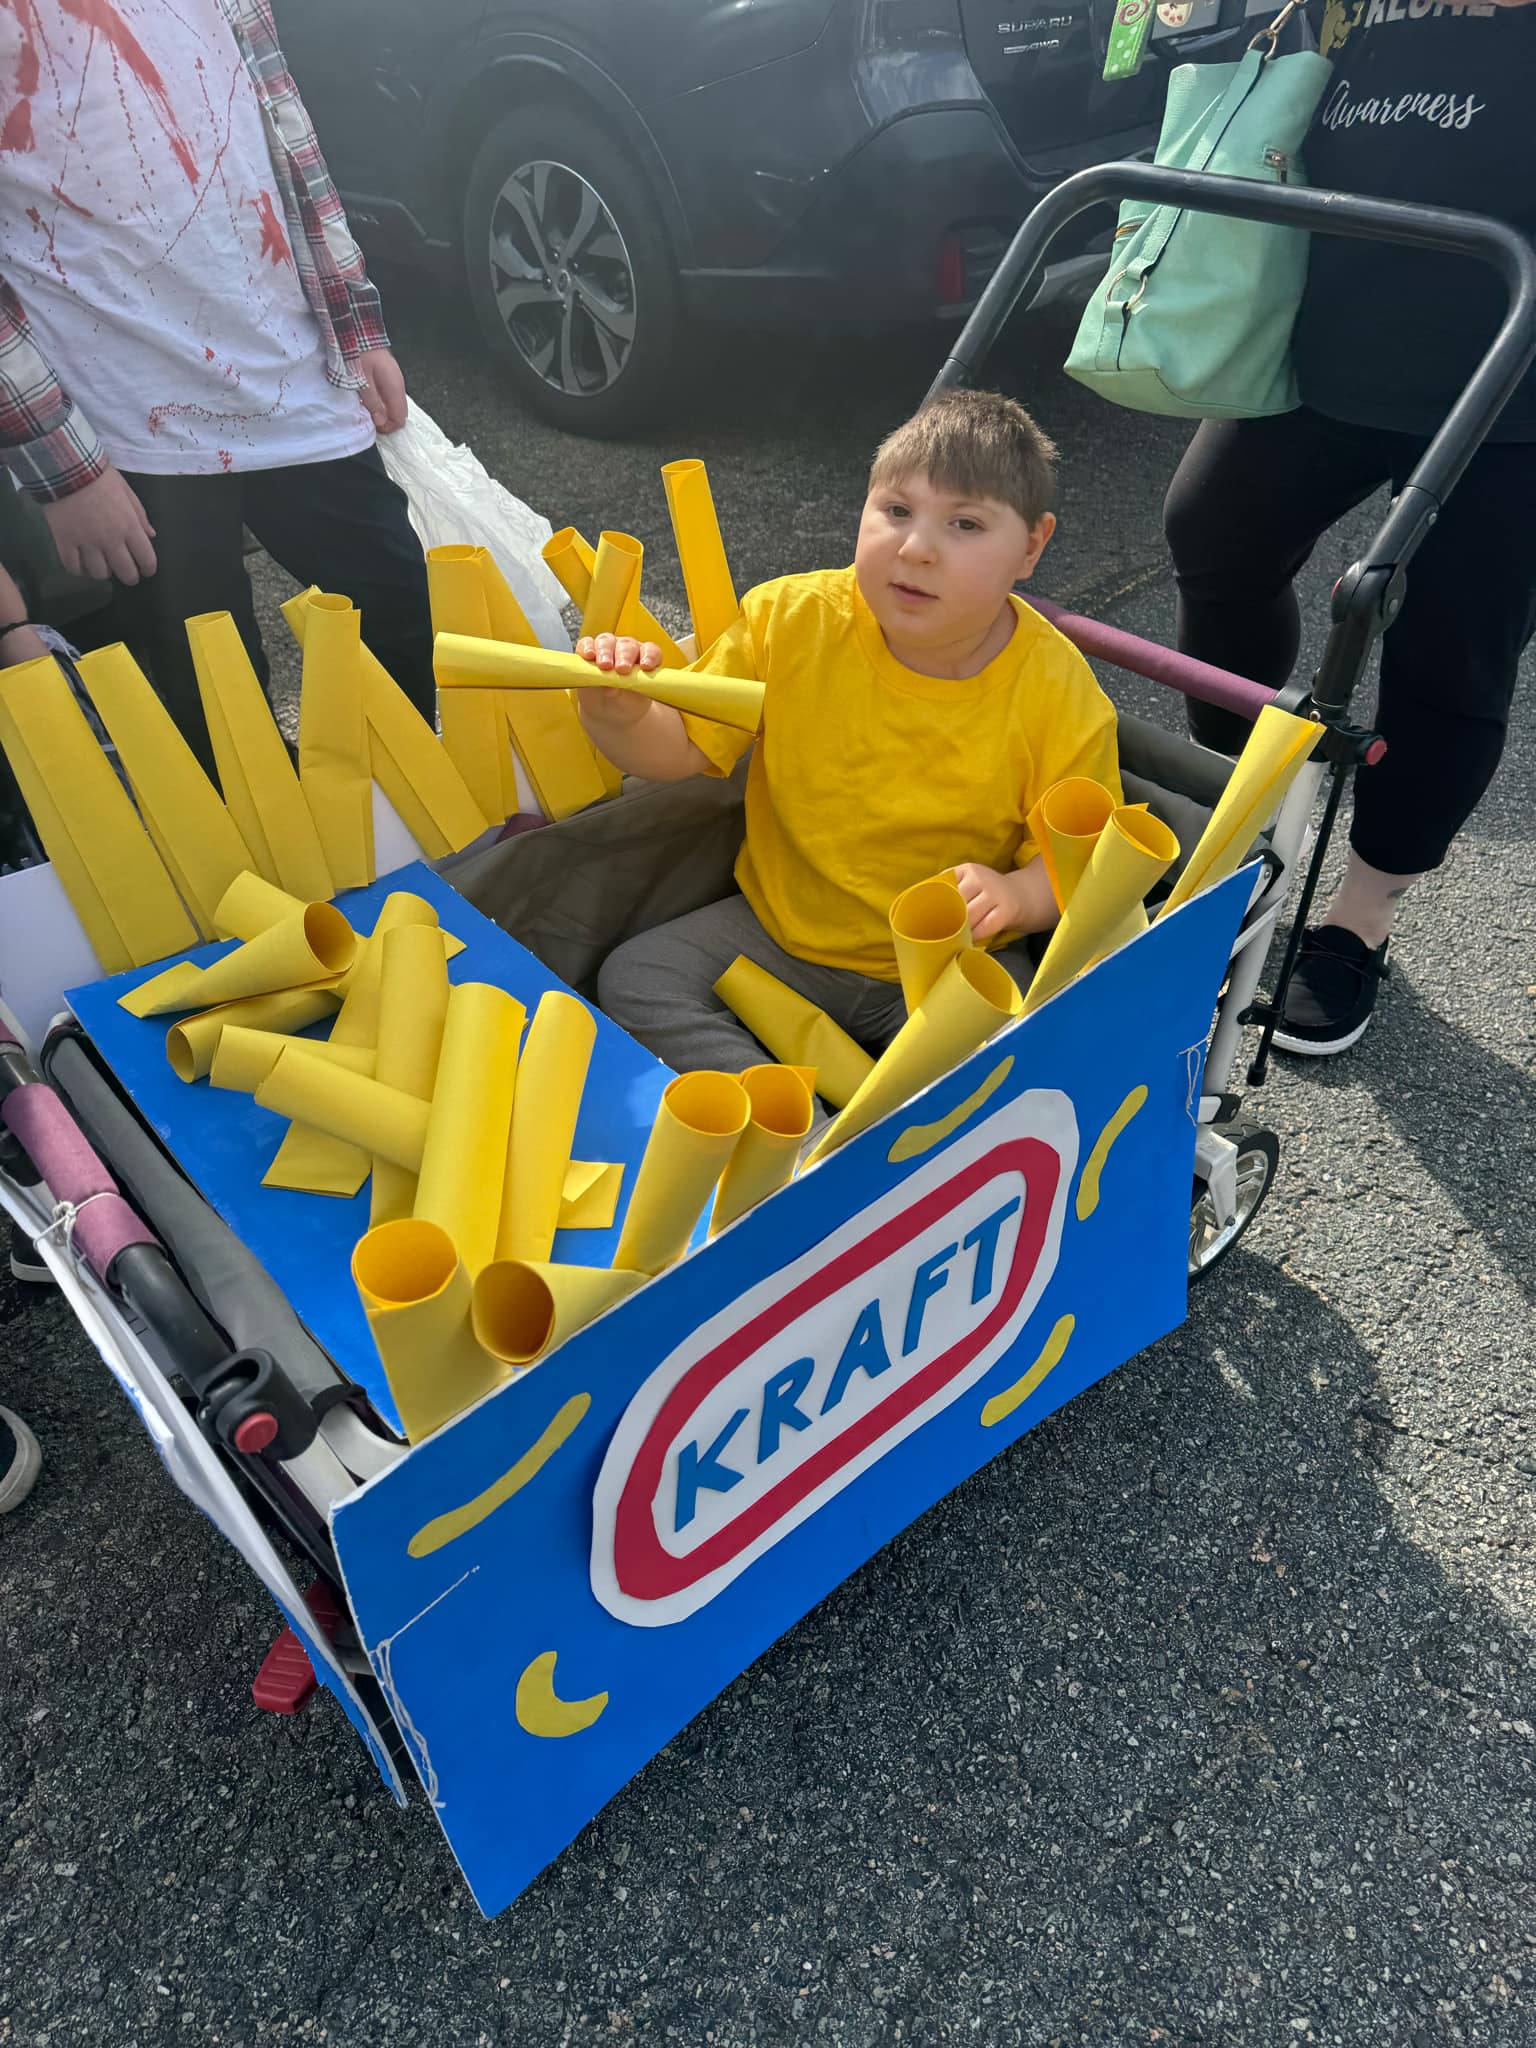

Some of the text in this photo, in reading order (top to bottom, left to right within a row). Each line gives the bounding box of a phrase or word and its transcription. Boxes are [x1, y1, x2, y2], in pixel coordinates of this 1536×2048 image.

[997, 15, 1073, 34] SUBARU
[1322, 79, 1487, 131] Awareness
[674, 1195, 1022, 1534] KRAFT
